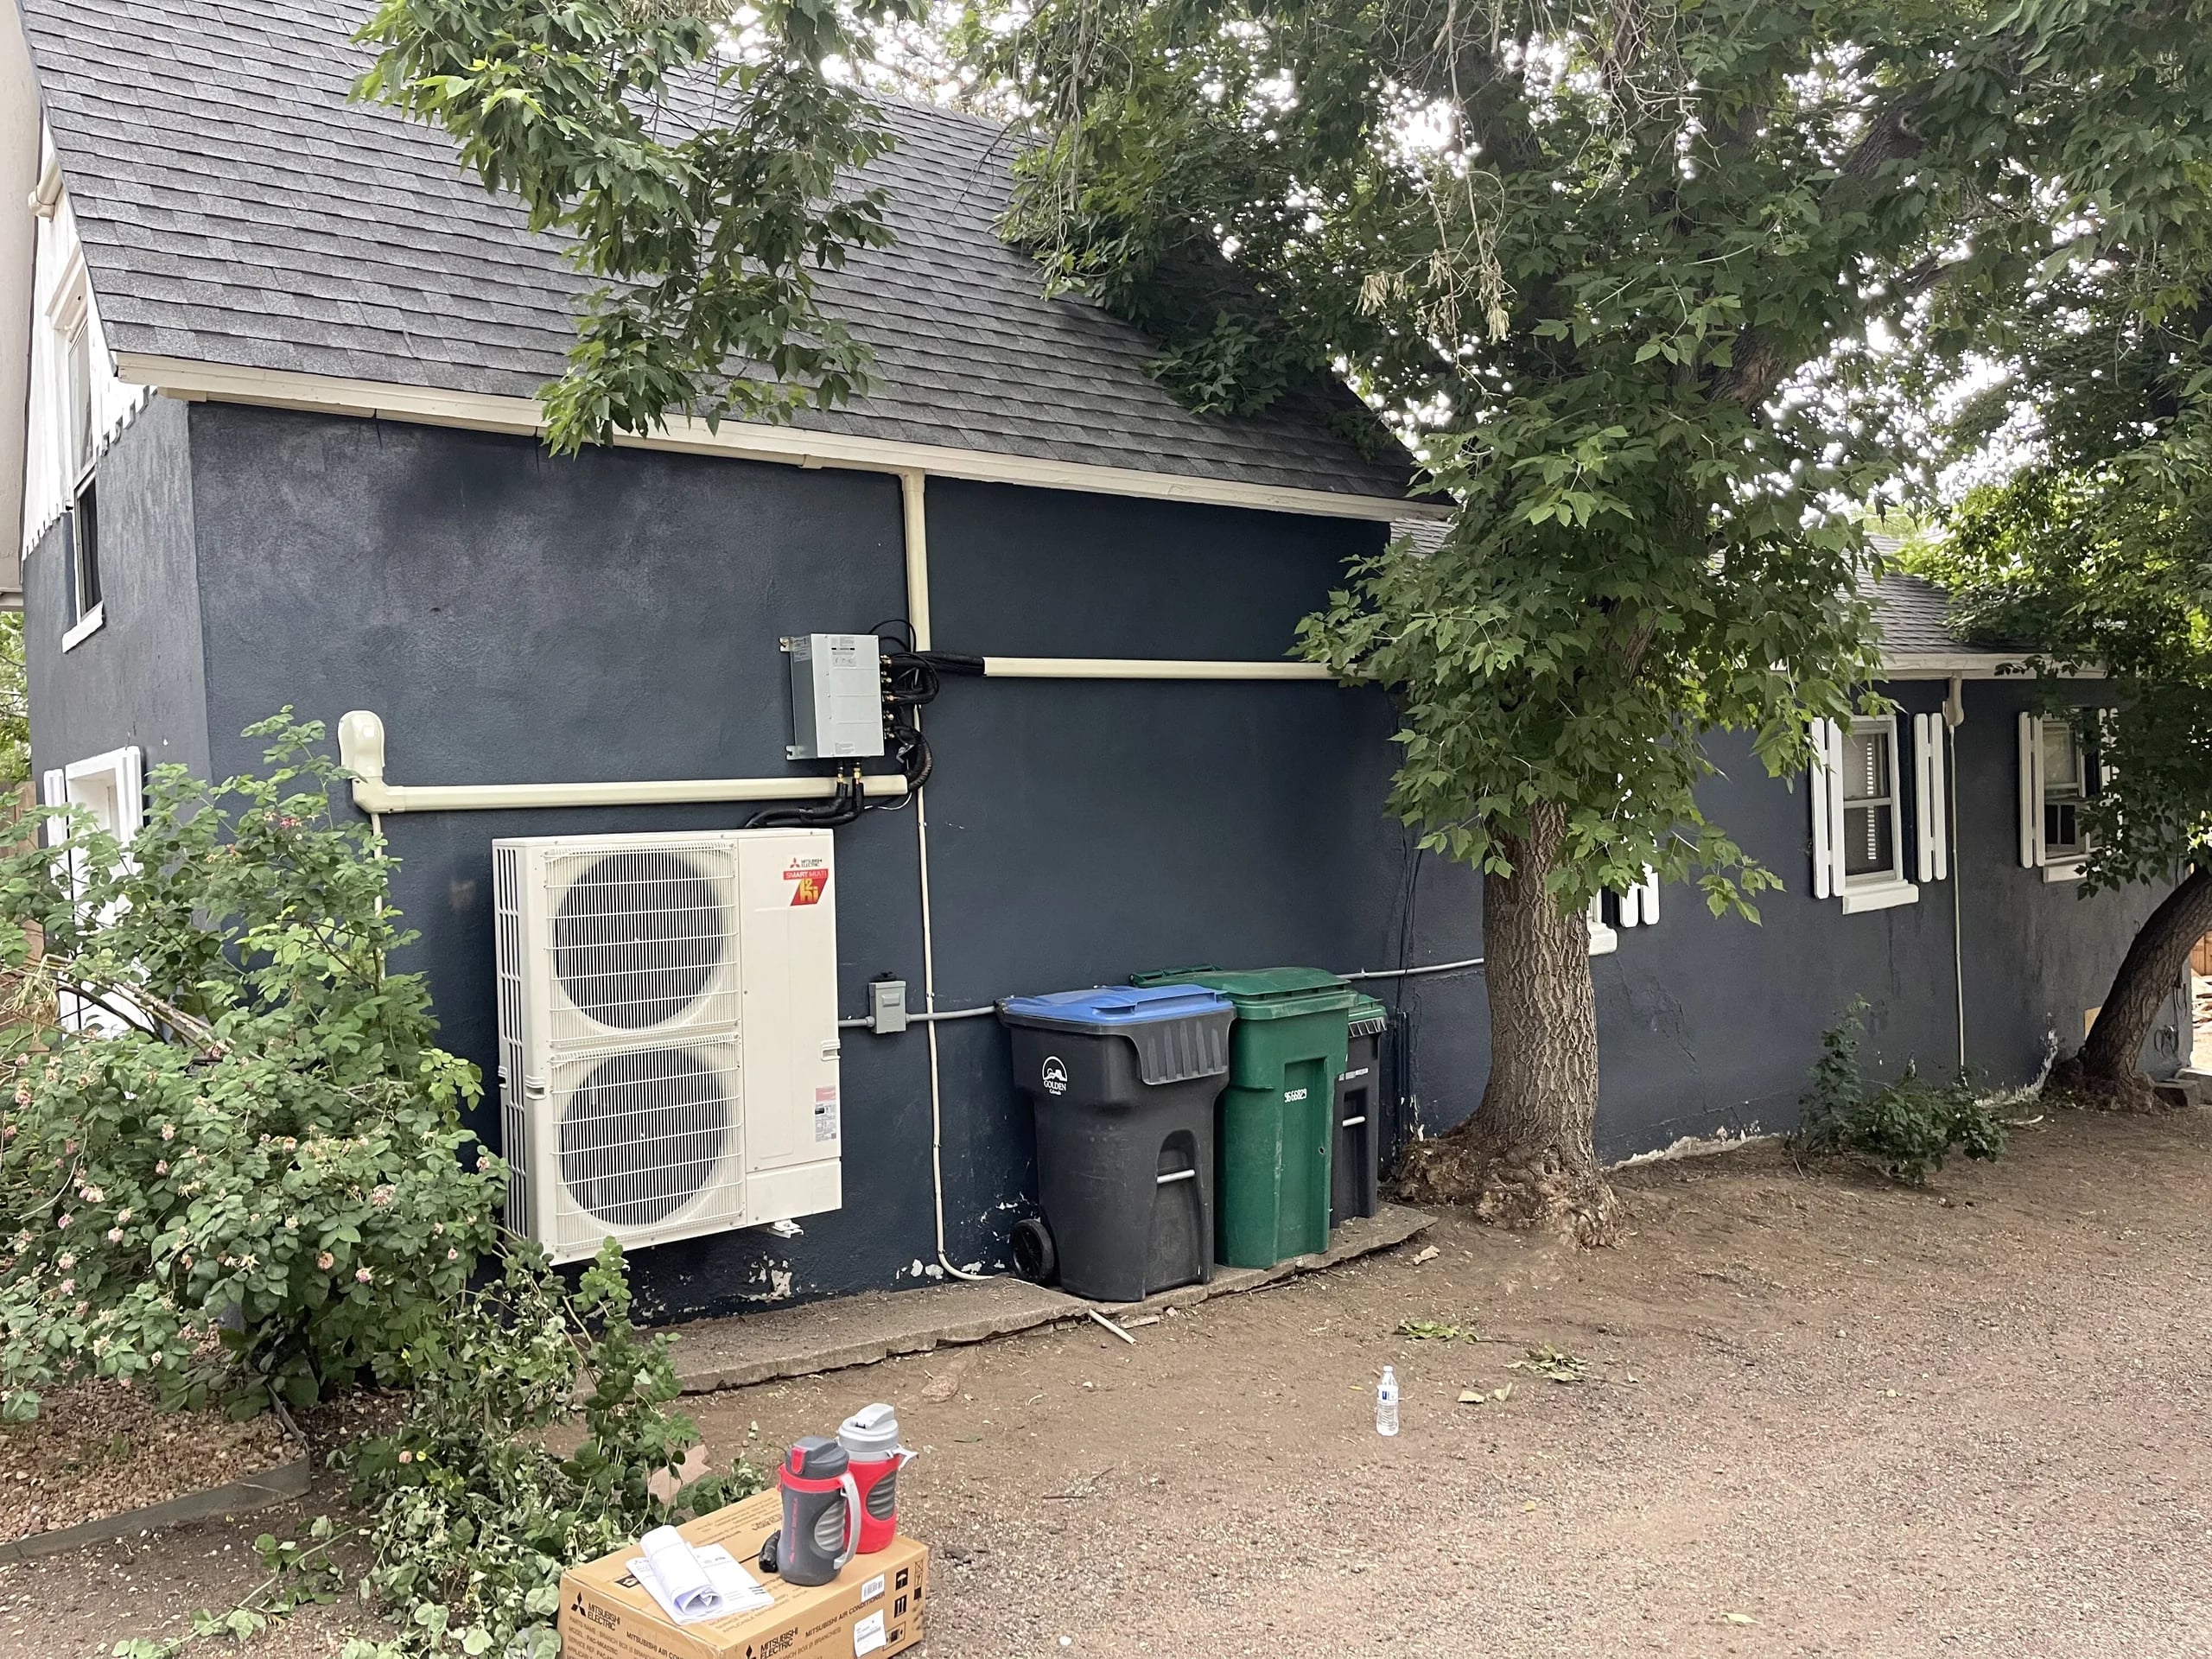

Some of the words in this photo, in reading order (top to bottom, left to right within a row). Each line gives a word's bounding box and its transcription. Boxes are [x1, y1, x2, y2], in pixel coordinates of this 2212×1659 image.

[1043, 1080, 1067, 1091] GOLDEN
[588, 1603, 620, 1625] MITSUBISHI
[588, 1611, 616, 1631] ELECTRIC
[805, 1616, 838, 1638] MITSUBISHI
[838, 1611, 849, 1621] AIR
[849, 1591, 885, 1615] CONDITIONER
[626, 1631, 658, 1652] MITSUBISHI
[658, 1647, 668, 1658] AIR
[760, 1626, 798, 1653] MITSUBISHI
